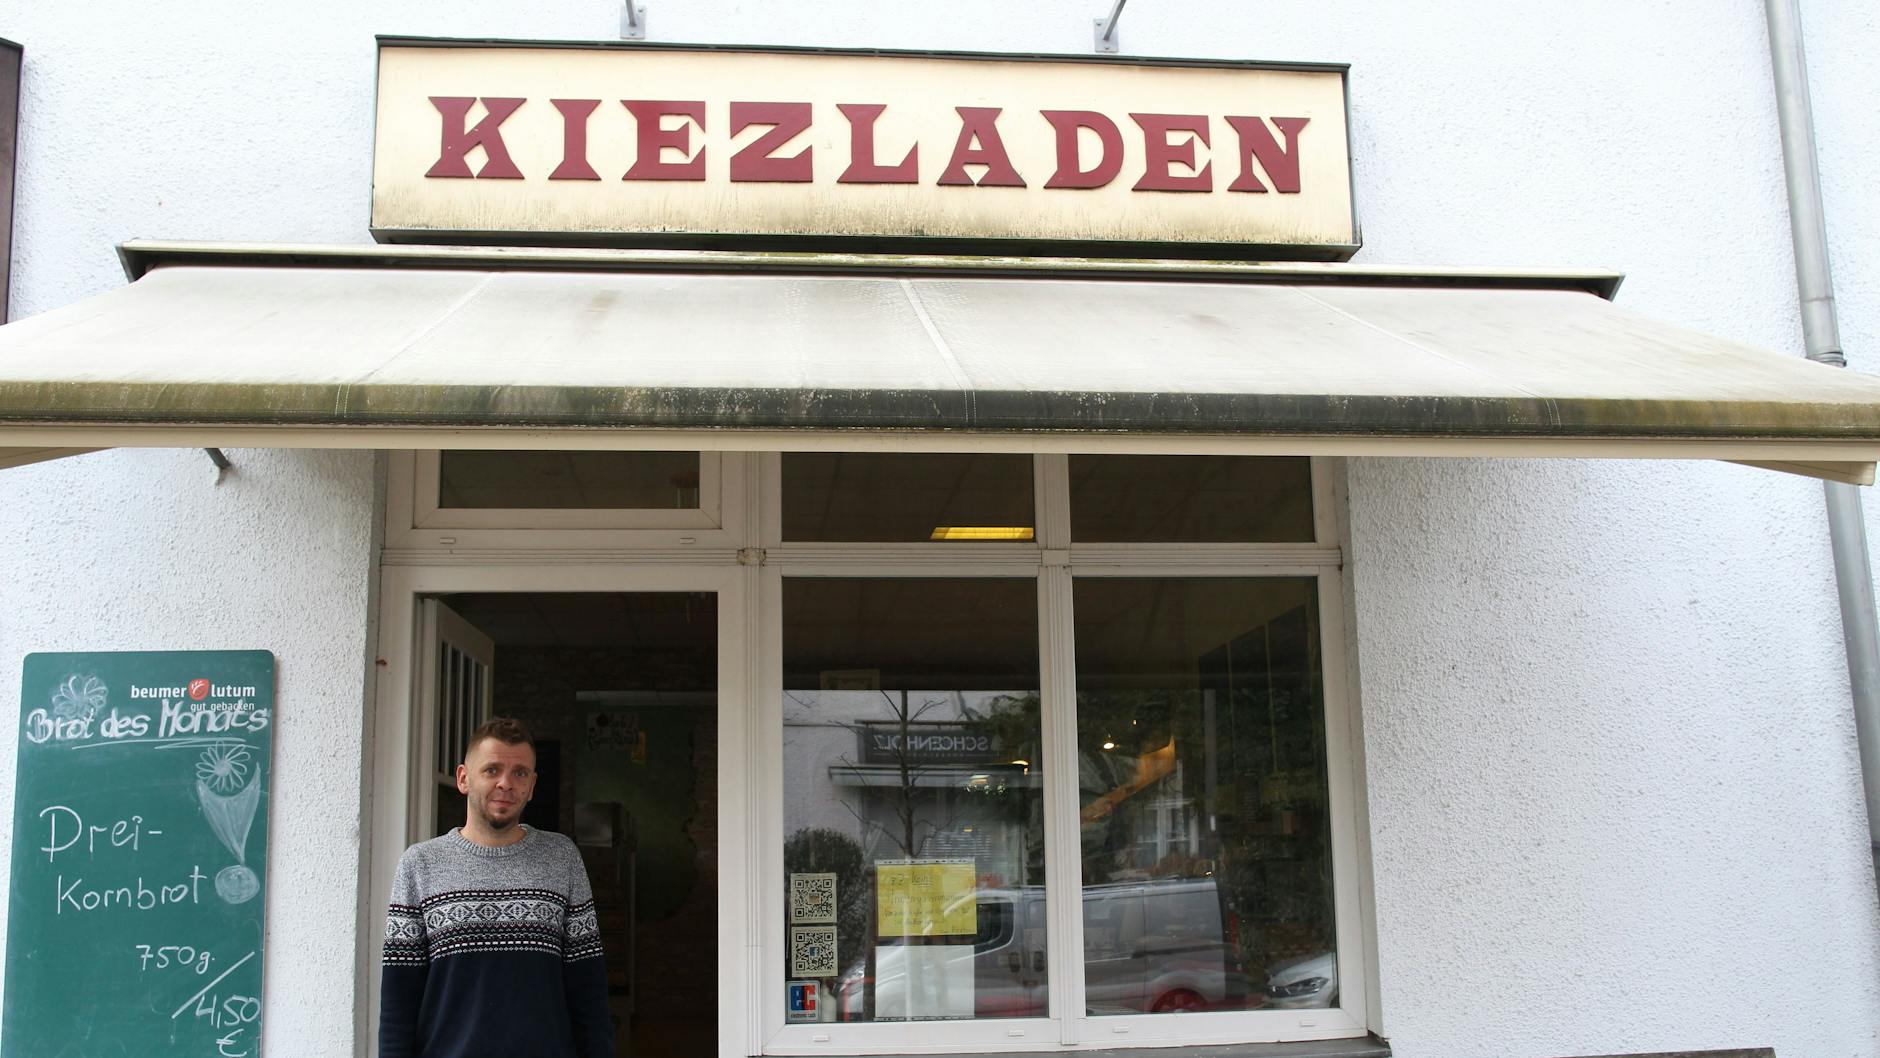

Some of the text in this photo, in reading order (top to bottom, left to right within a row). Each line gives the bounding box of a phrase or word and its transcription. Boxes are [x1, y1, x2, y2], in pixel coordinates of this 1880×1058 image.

[425, 96, 1311, 193] KIEZLADEN
[131, 685, 256, 698] beumer lutum
[190, 702, 255, 713] gut gebacken
[27, 699, 270, 744] Brot des Monats
[39, 805, 163, 863] Drei-
[57, 865, 208, 915] Kornbrot
[215, 1028, 248, 1058] €
